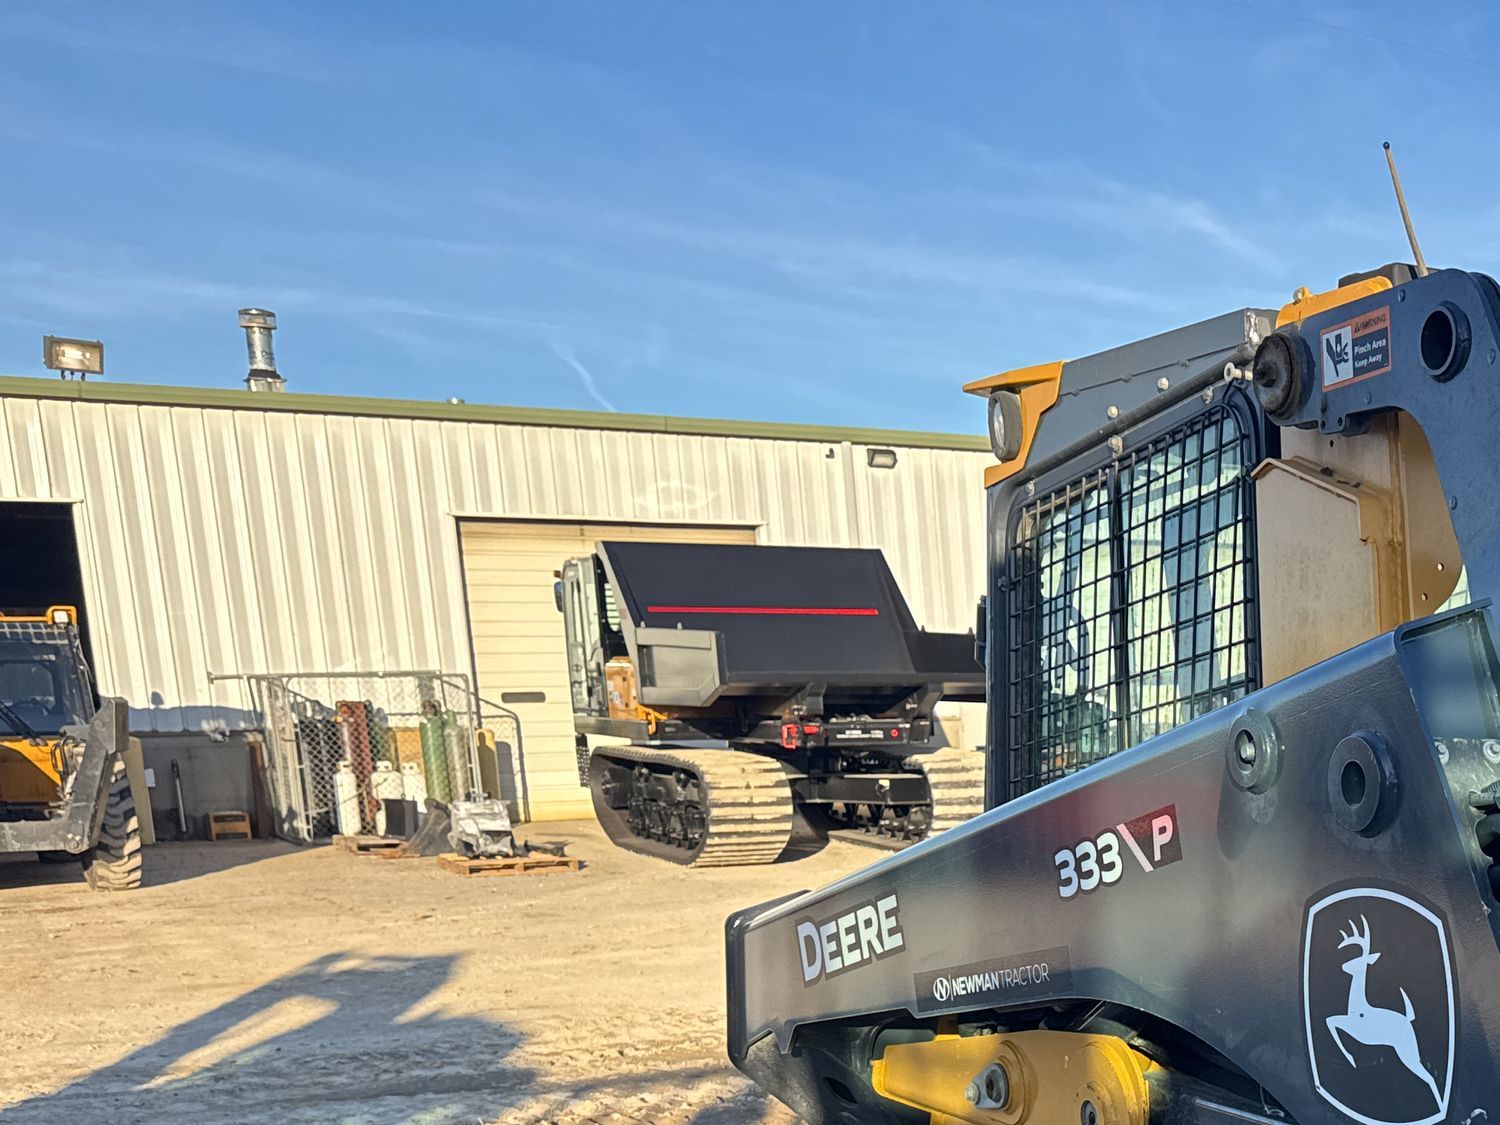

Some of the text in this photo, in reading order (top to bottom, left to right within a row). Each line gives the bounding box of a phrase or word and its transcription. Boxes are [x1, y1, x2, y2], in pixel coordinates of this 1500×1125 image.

[1354, 338, 1387, 356] Pinch Area
[1354, 354, 1383, 368] Keep Away
[1054, 832, 1123, 898] 333
[797, 894, 903, 982] DEERE
